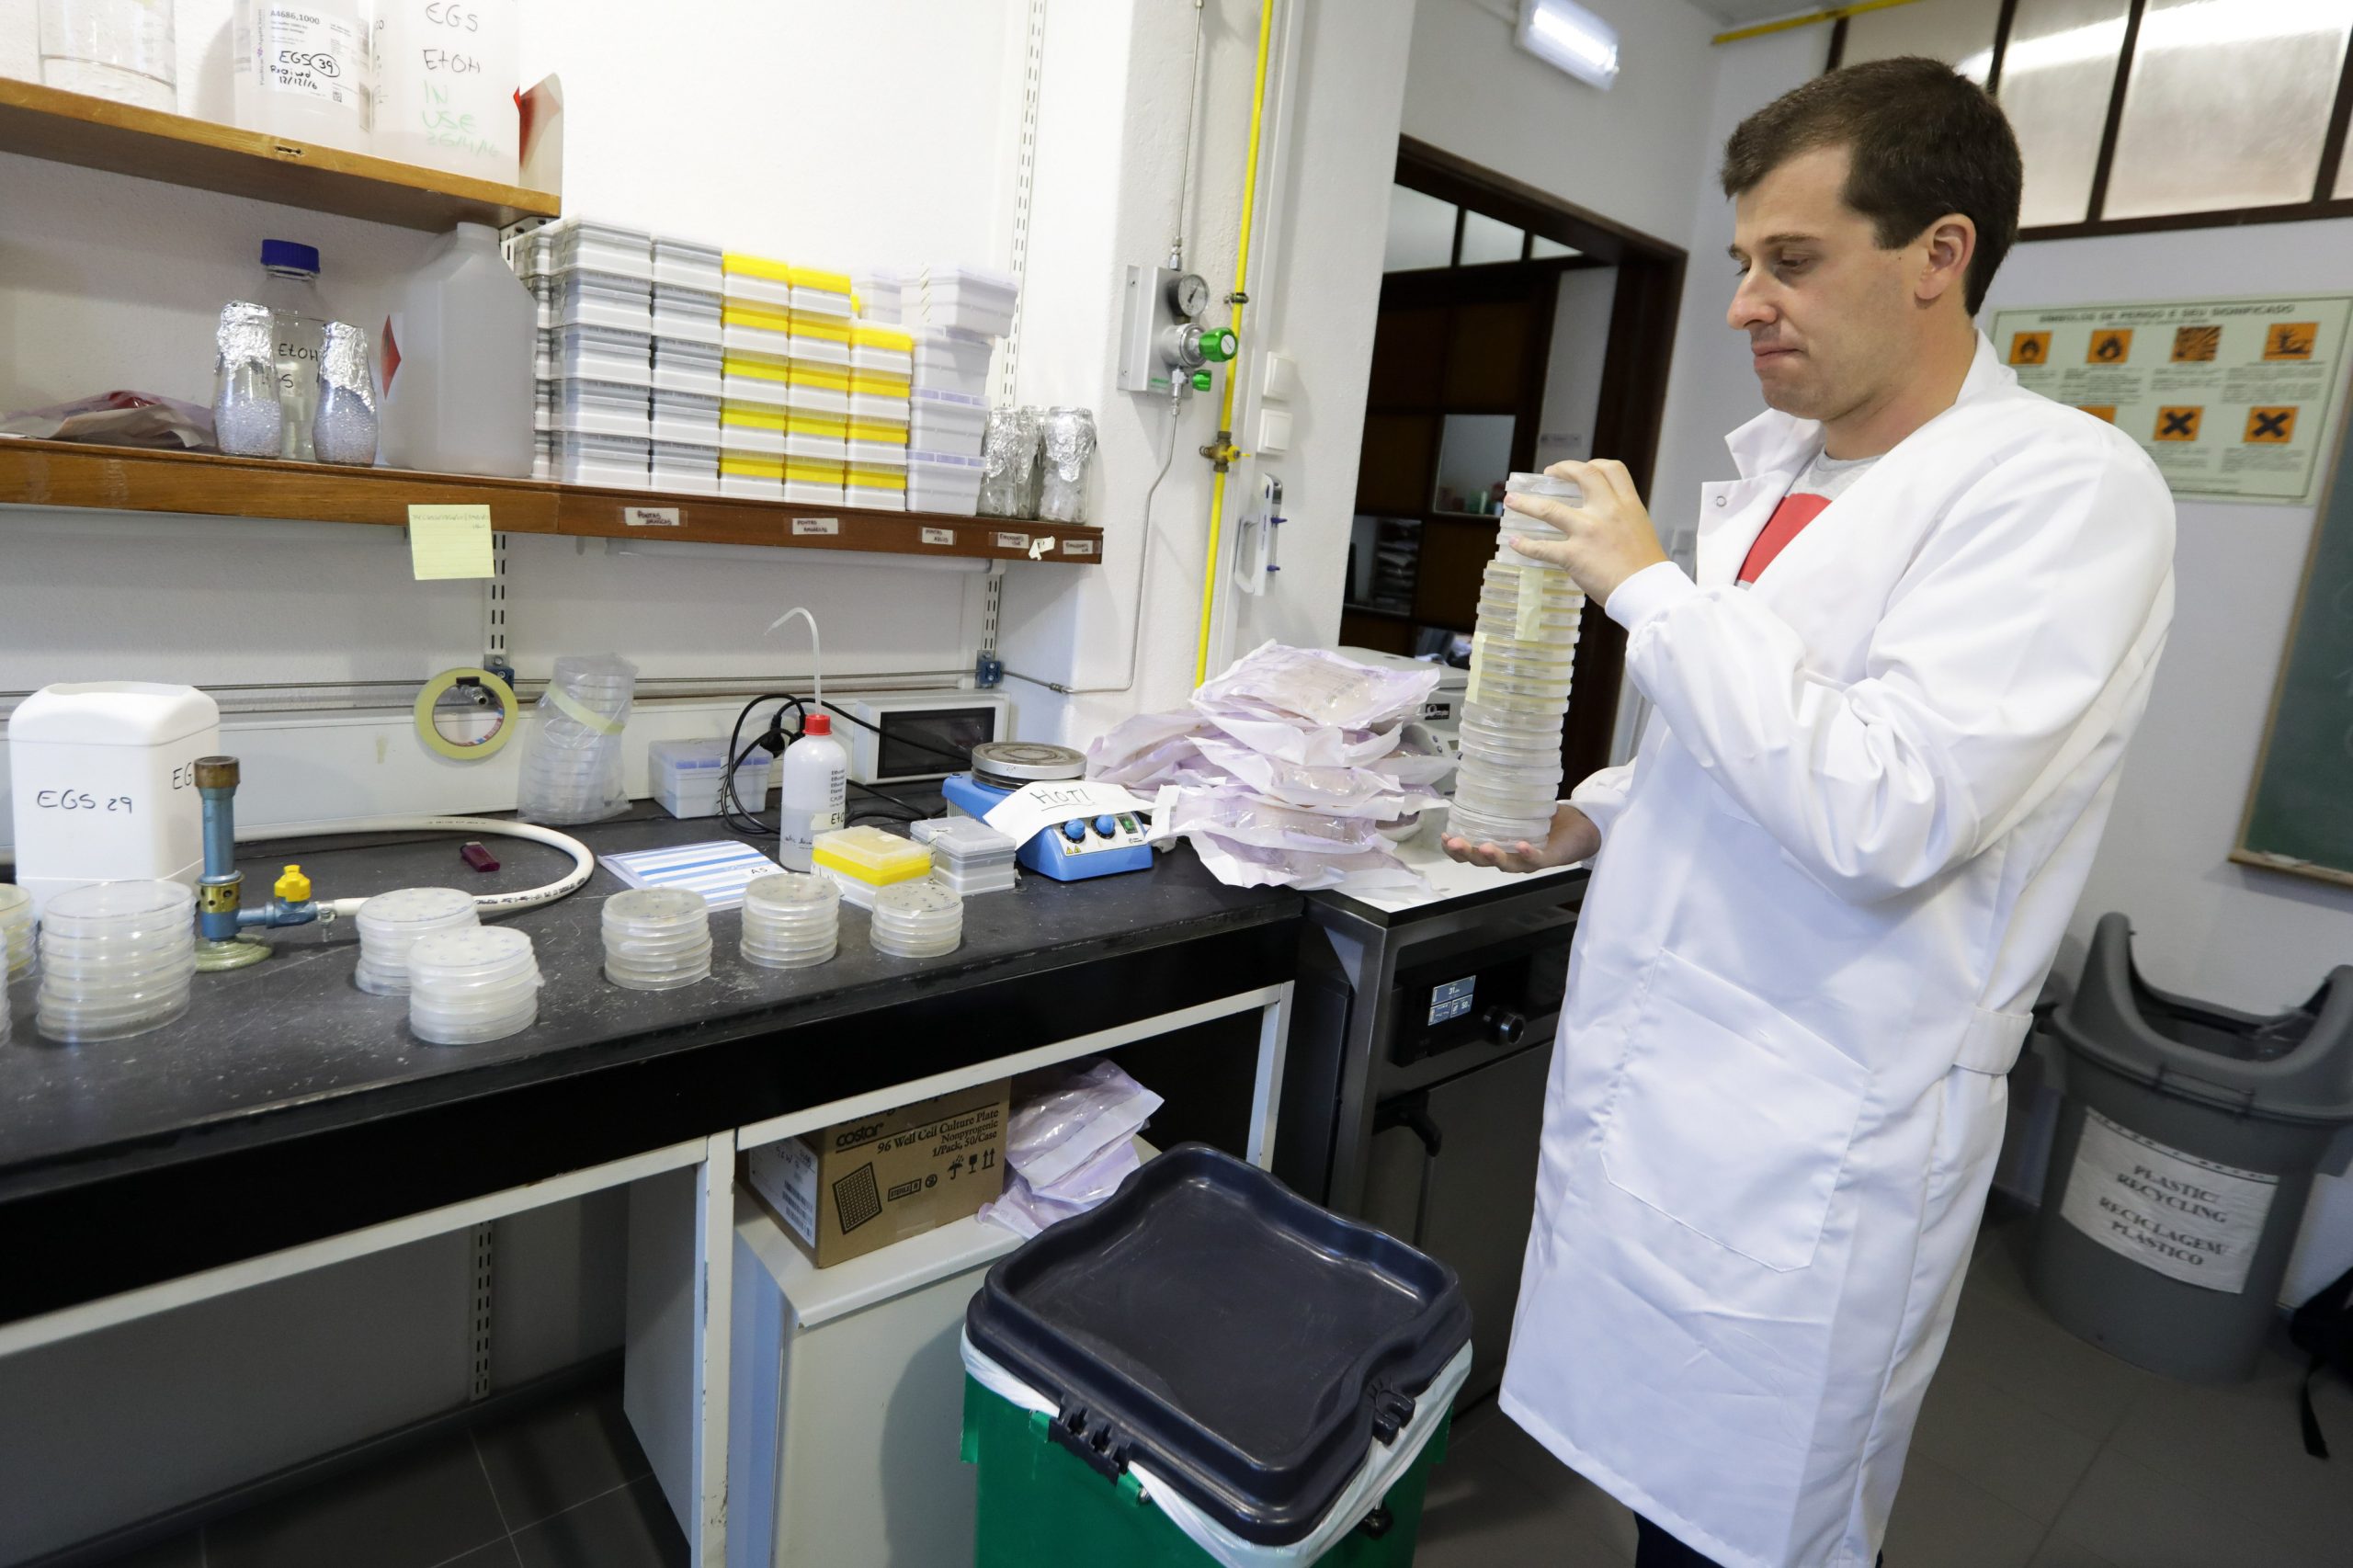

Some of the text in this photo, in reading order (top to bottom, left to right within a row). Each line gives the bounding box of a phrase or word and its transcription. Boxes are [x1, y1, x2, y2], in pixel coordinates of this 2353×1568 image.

[270, 10, 320, 25] A4686,1000
[426, 2, 478, 32] EGS
[279, 51, 334, 74] EGS 39
[423, 49, 481, 74] EtOH
[421, 80, 449, 104] IN
[278, 343, 319, 362] EtOH
[37, 790, 132, 814] EGS 29
[1029, 788, 1097, 804] HOT!
[835, 1122, 881, 1148] costar
[877, 1108, 999, 1154] 96 Well Cell Culture Plate
[941, 1119, 998, 1143] Nonpyrogenic
[964, 1130, 997, 1148] 50/Case
[2133, 1165, 2219, 1203] PLASTIC
[2116, 1173, 2228, 1223] RECYCLING
[2098, 1196, 2222, 1256] RECICLAGEM
